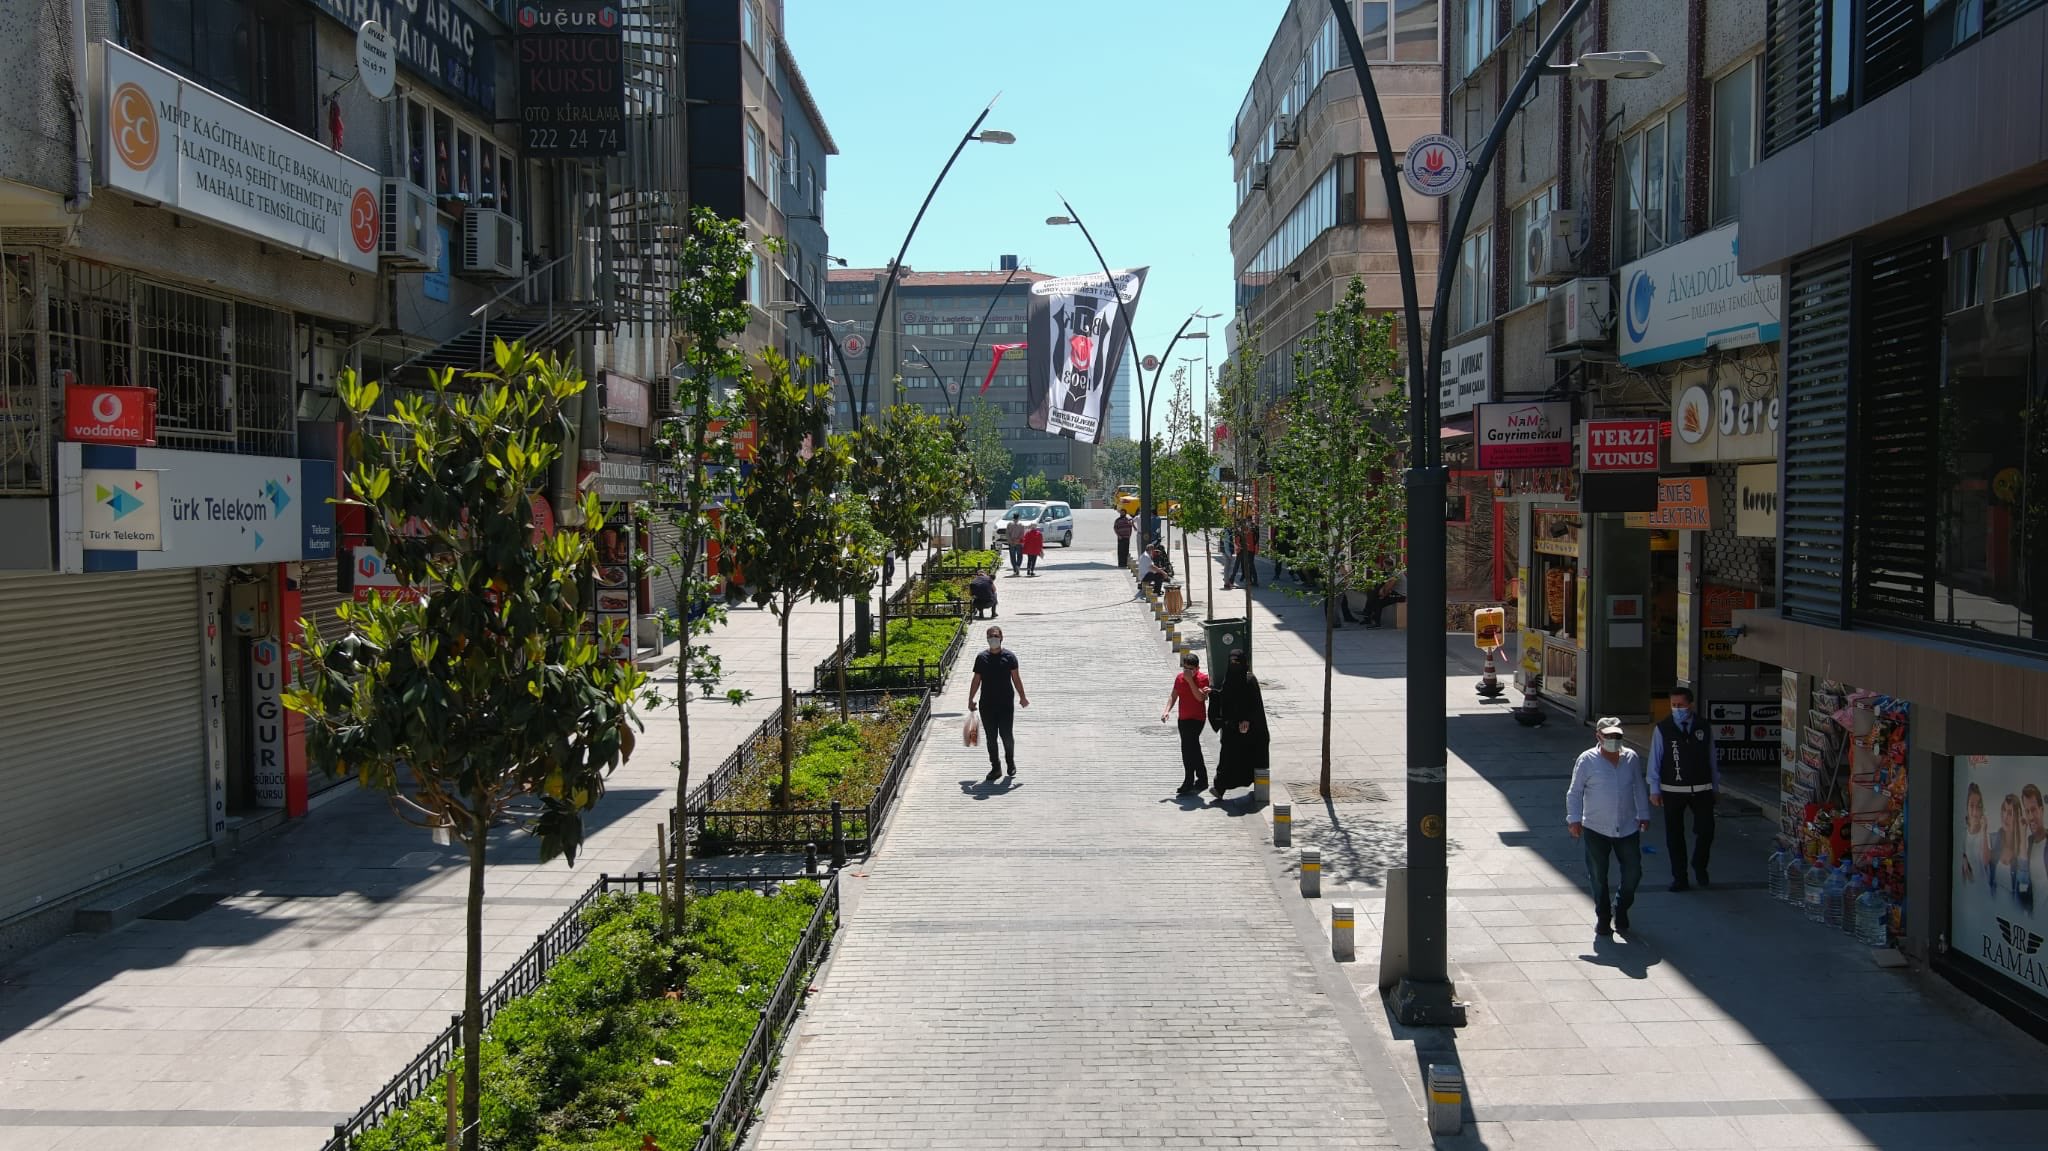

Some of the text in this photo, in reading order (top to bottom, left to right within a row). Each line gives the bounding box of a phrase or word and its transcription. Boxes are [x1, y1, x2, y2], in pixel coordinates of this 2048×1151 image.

[538, 8, 594, 25] UĞUR
[426, 0, 475, 66] ARAÇ
[529, 64, 610, 92] KURSU
[524, 99, 620, 121] OTO KİRALAMA
[159, 100, 353, 199] MHP KAĞITHANE İLÇE BAŞKANLIĞI
[529, 128, 618, 149] 222 24 74
[172, 134, 344, 217] TALATPAŞA ŞEHİT MEHMET PAT
[196, 171, 326, 235] MAHALLE TEMSİLCİLİĞİ
[1667, 260, 1736, 304] ANADOLU
[74, 423, 140, 438] vodafone
[1487, 427, 1562, 443] Gayrimenkul
[1592, 423, 1655, 446] TERZİ
[1592, 452, 1654, 466] YUNUS
[170, 496, 267, 522] ürk Telekom
[1649, 506, 1708, 525] ELEKTRİK
[89, 530, 155, 541] Türk Telekom
[257, 672, 278, 767] UĞUR
[1671, 740, 1683, 782] ZABITA
[1715, 747, 1726, 761] EP
[1728, 747, 1767, 761] TELEFONU
